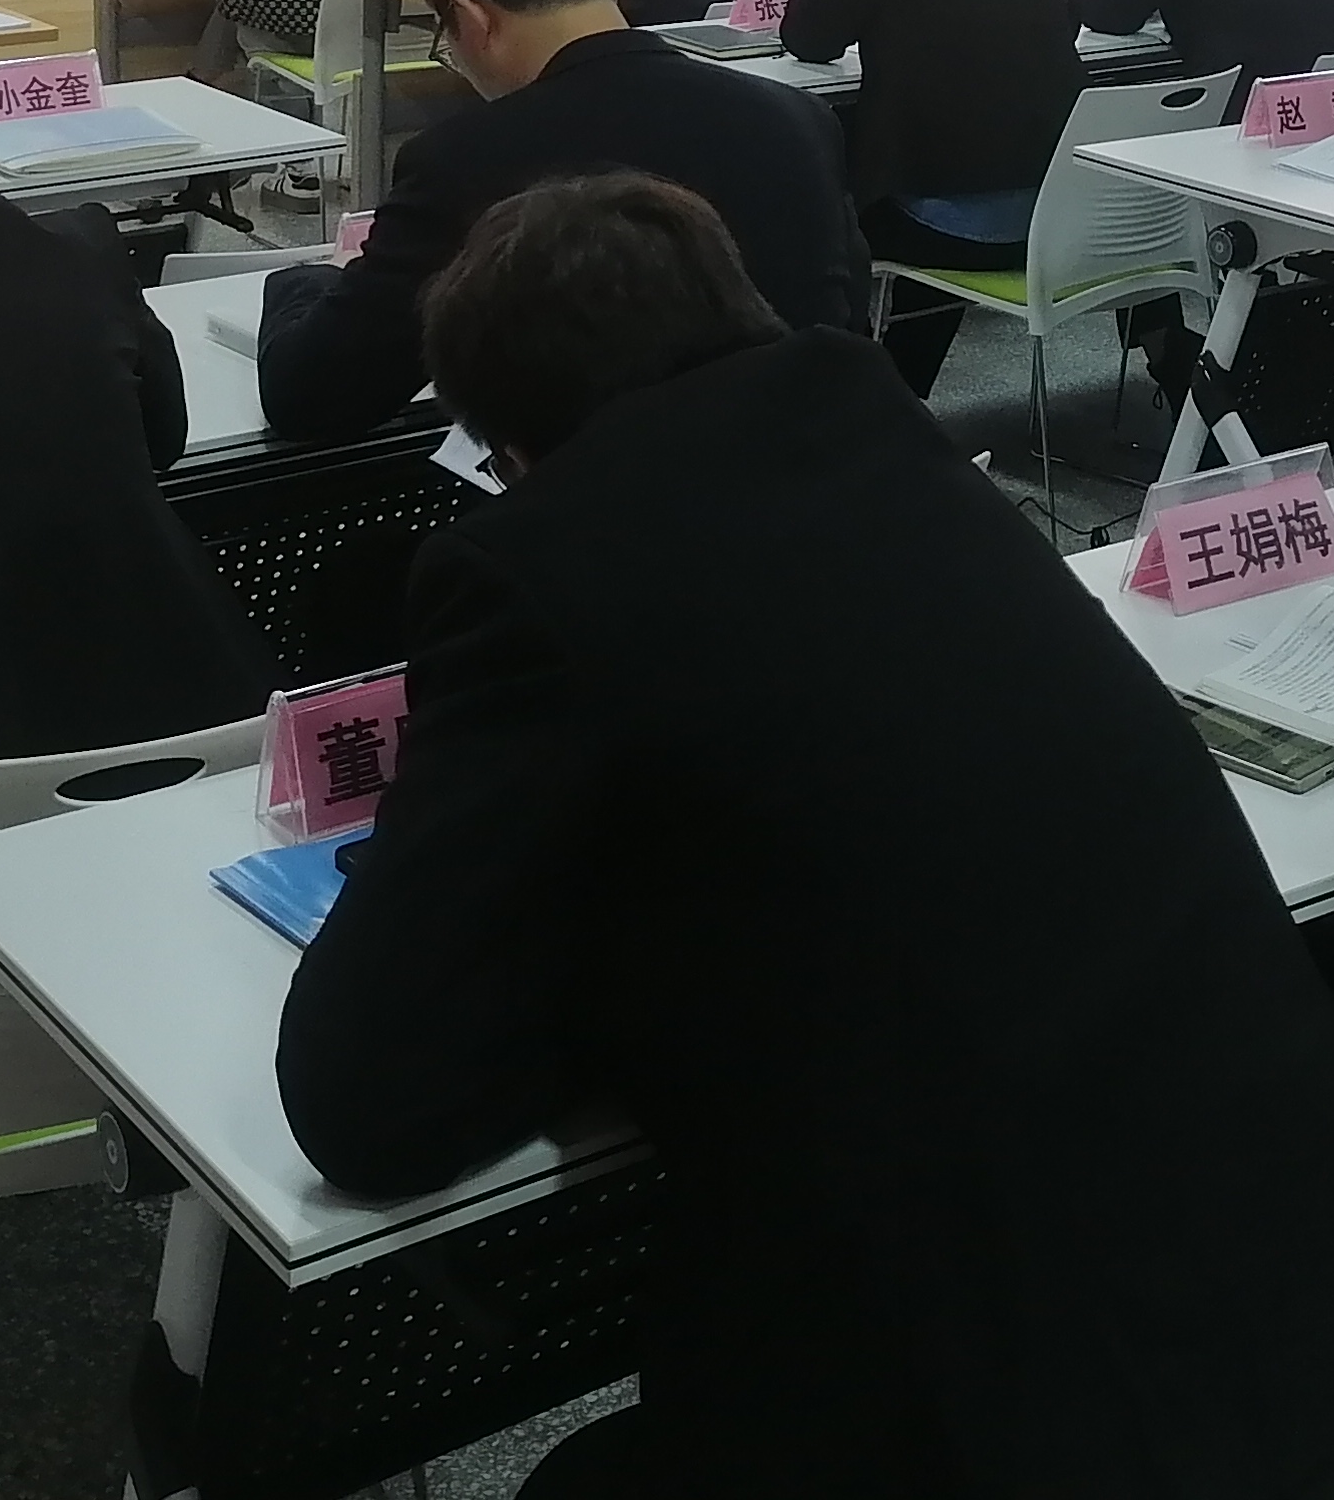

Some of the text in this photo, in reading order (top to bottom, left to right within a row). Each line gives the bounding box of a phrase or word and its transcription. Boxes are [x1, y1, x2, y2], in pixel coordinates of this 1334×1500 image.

[1276, 94, 1307, 135] 赵
[1179, 497, 1333, 591] 王娟梅
